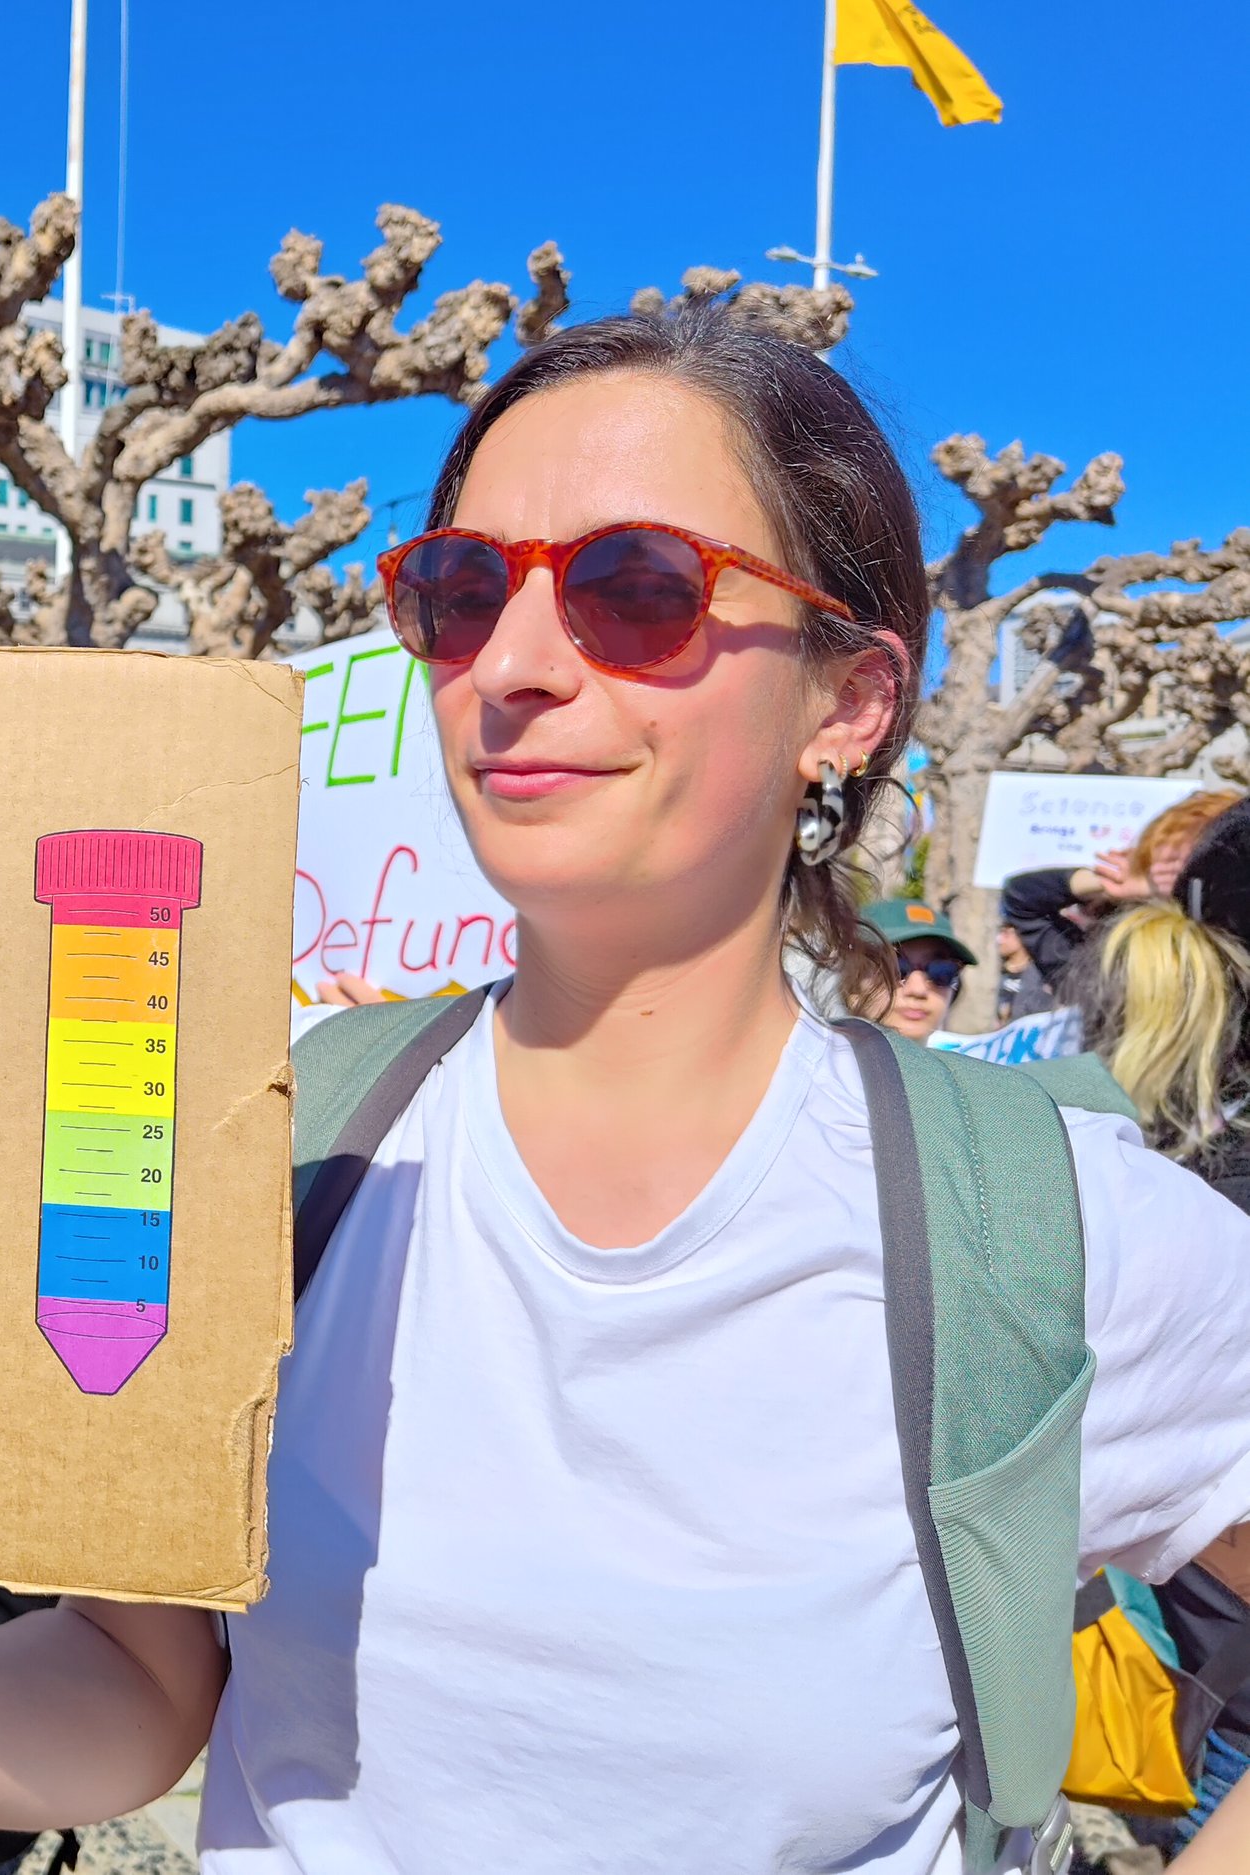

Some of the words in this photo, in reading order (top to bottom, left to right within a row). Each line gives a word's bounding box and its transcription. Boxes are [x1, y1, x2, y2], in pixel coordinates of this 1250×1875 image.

[149, 906, 172, 923] 50
[147, 950, 171, 967] 45
[146, 994, 169, 1011] 40
[144, 1037, 167, 1054] 35
[142, 1080, 166, 1098] 30
[141, 1124, 165, 1141] 25
[139, 1167, 163, 1184] 20
[139, 1211, 161, 1228] 15
[137, 1254, 160, 1271] 10
[135, 1297, 147, 1313] 5
